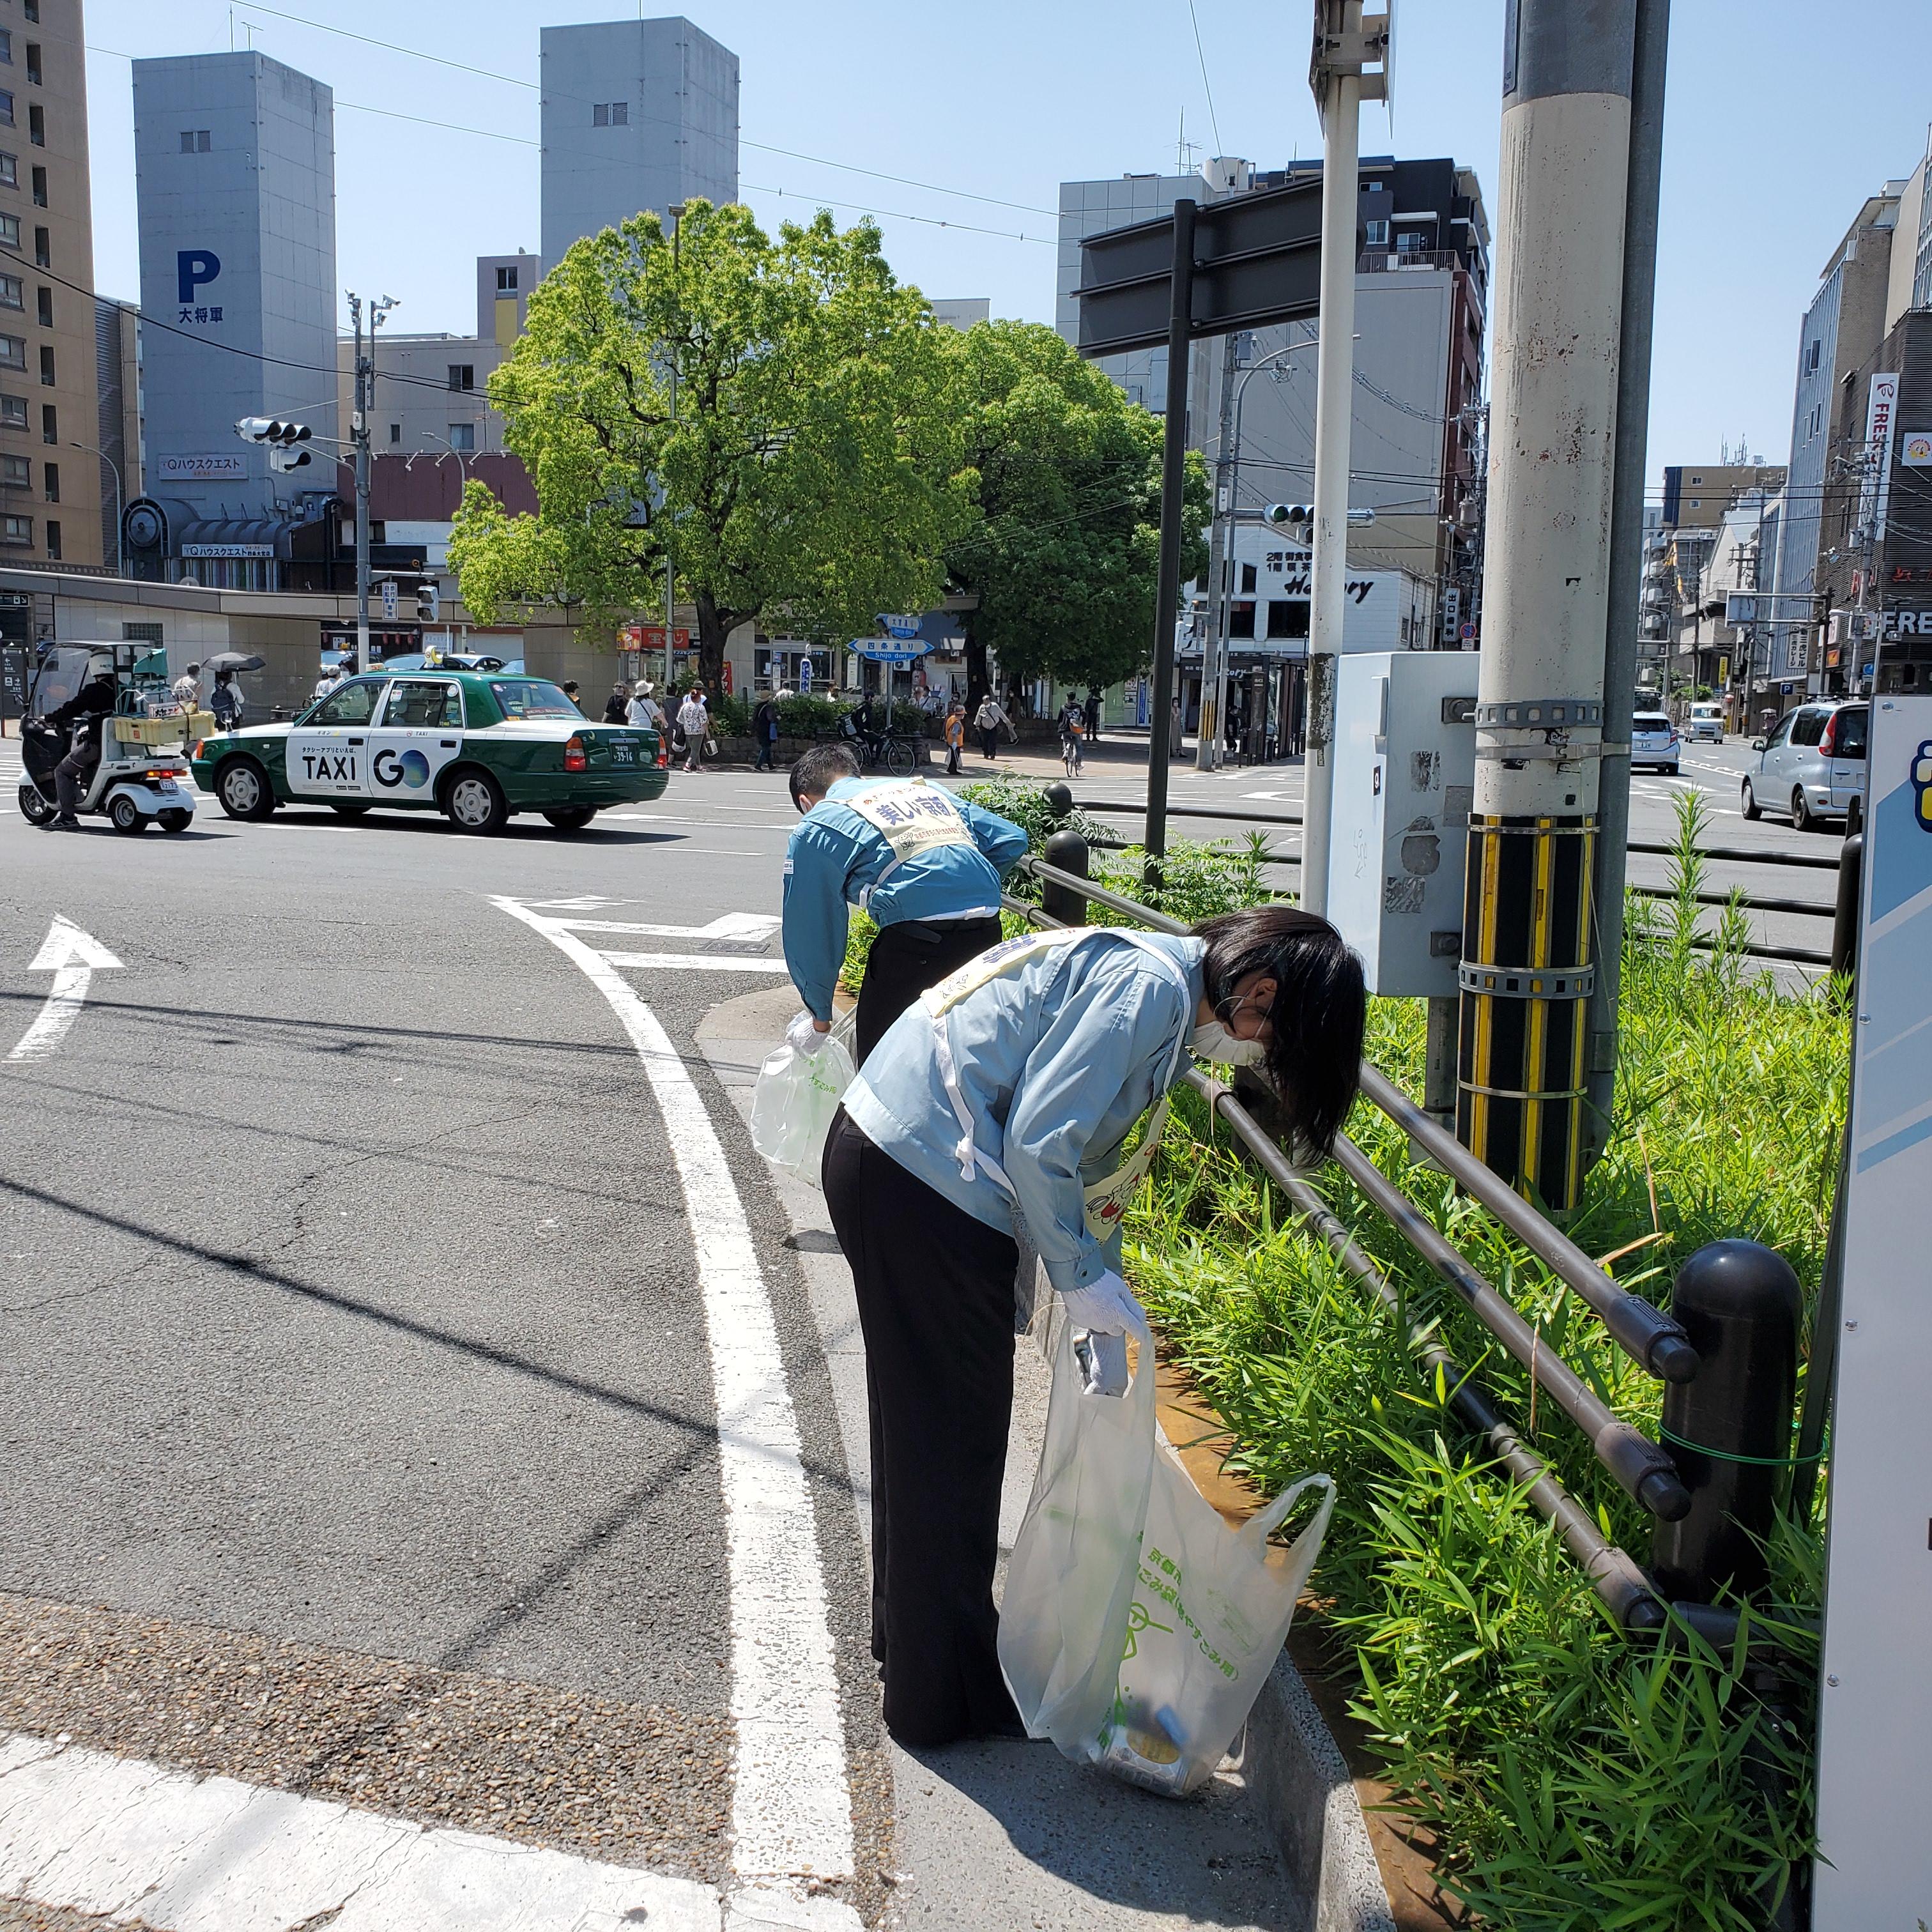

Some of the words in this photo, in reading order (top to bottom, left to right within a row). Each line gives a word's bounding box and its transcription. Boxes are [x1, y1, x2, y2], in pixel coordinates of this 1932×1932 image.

[177, 250, 221, 303] P
[178, 307, 224, 324] 大将軍
[1266, 552, 1283, 562] 2階
[1266, 562, 1283, 572] 1階
[868, 642, 914, 650] 四条通り
[617, 751, 633, 762] 39-16
[302, 756, 356, 781] TAXI
